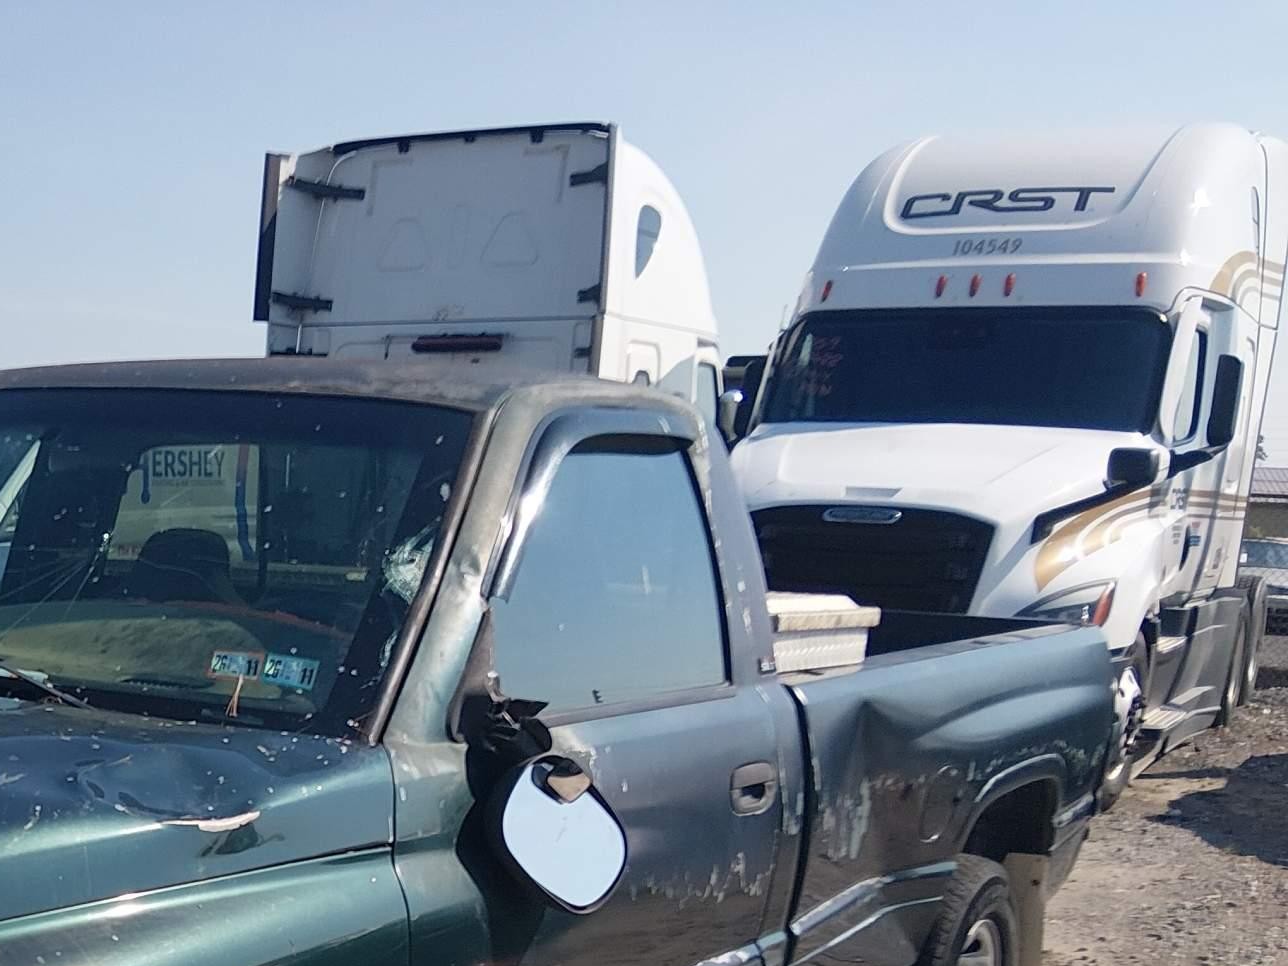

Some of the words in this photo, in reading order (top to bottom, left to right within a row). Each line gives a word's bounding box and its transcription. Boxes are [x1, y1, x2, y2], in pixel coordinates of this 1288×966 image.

[900, 186, 1116, 220] CRST
[952, 238, 1023, 256] 104549
[152, 449, 225, 478] ERSHEY
[246, 659, 258, 677] 11
[300, 667, 314, 685] 11
